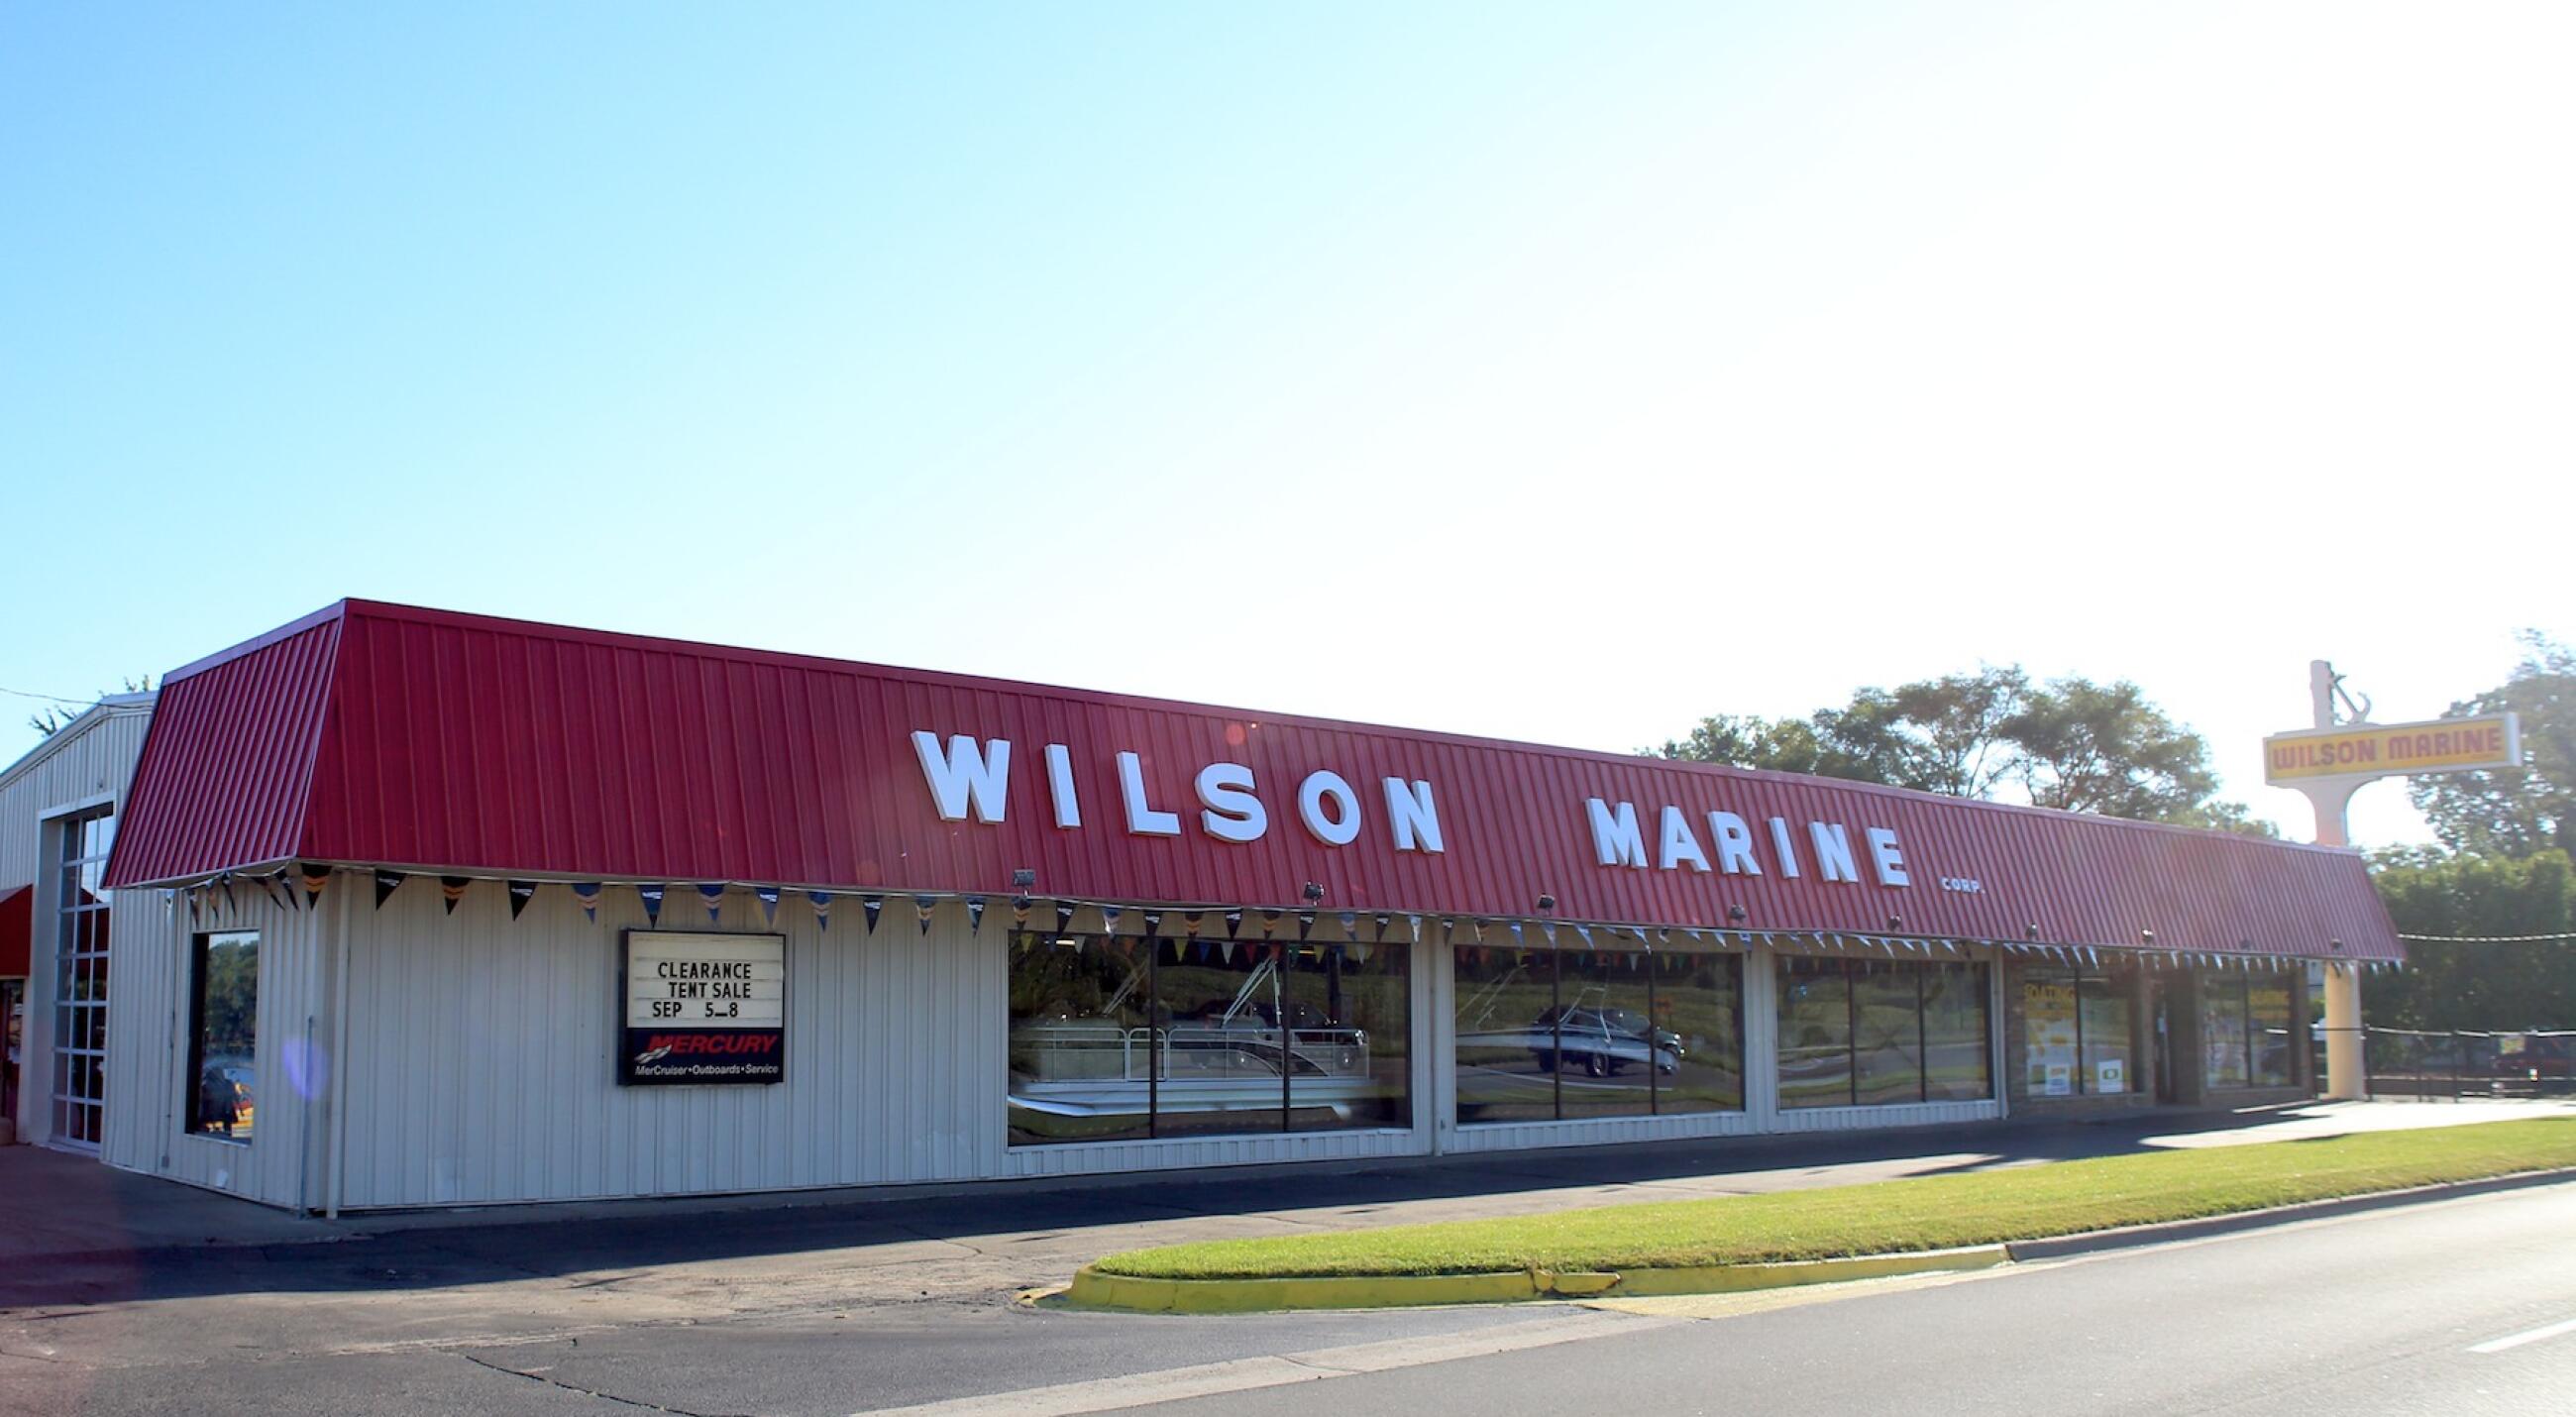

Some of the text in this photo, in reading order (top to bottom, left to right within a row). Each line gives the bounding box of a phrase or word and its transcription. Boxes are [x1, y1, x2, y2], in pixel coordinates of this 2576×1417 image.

[2272, 726, 2502, 770] WILSON MARINE
[911, 730, 1445, 853] WILSON
[1585, 798, 1910, 887] MARINE
[658, 962, 751, 979] CLEARANCE
[669, 982, 751, 999] TENT SALE
[652, 1002, 682, 1018] SEP
[647, 1035, 777, 1054] MERCURY
